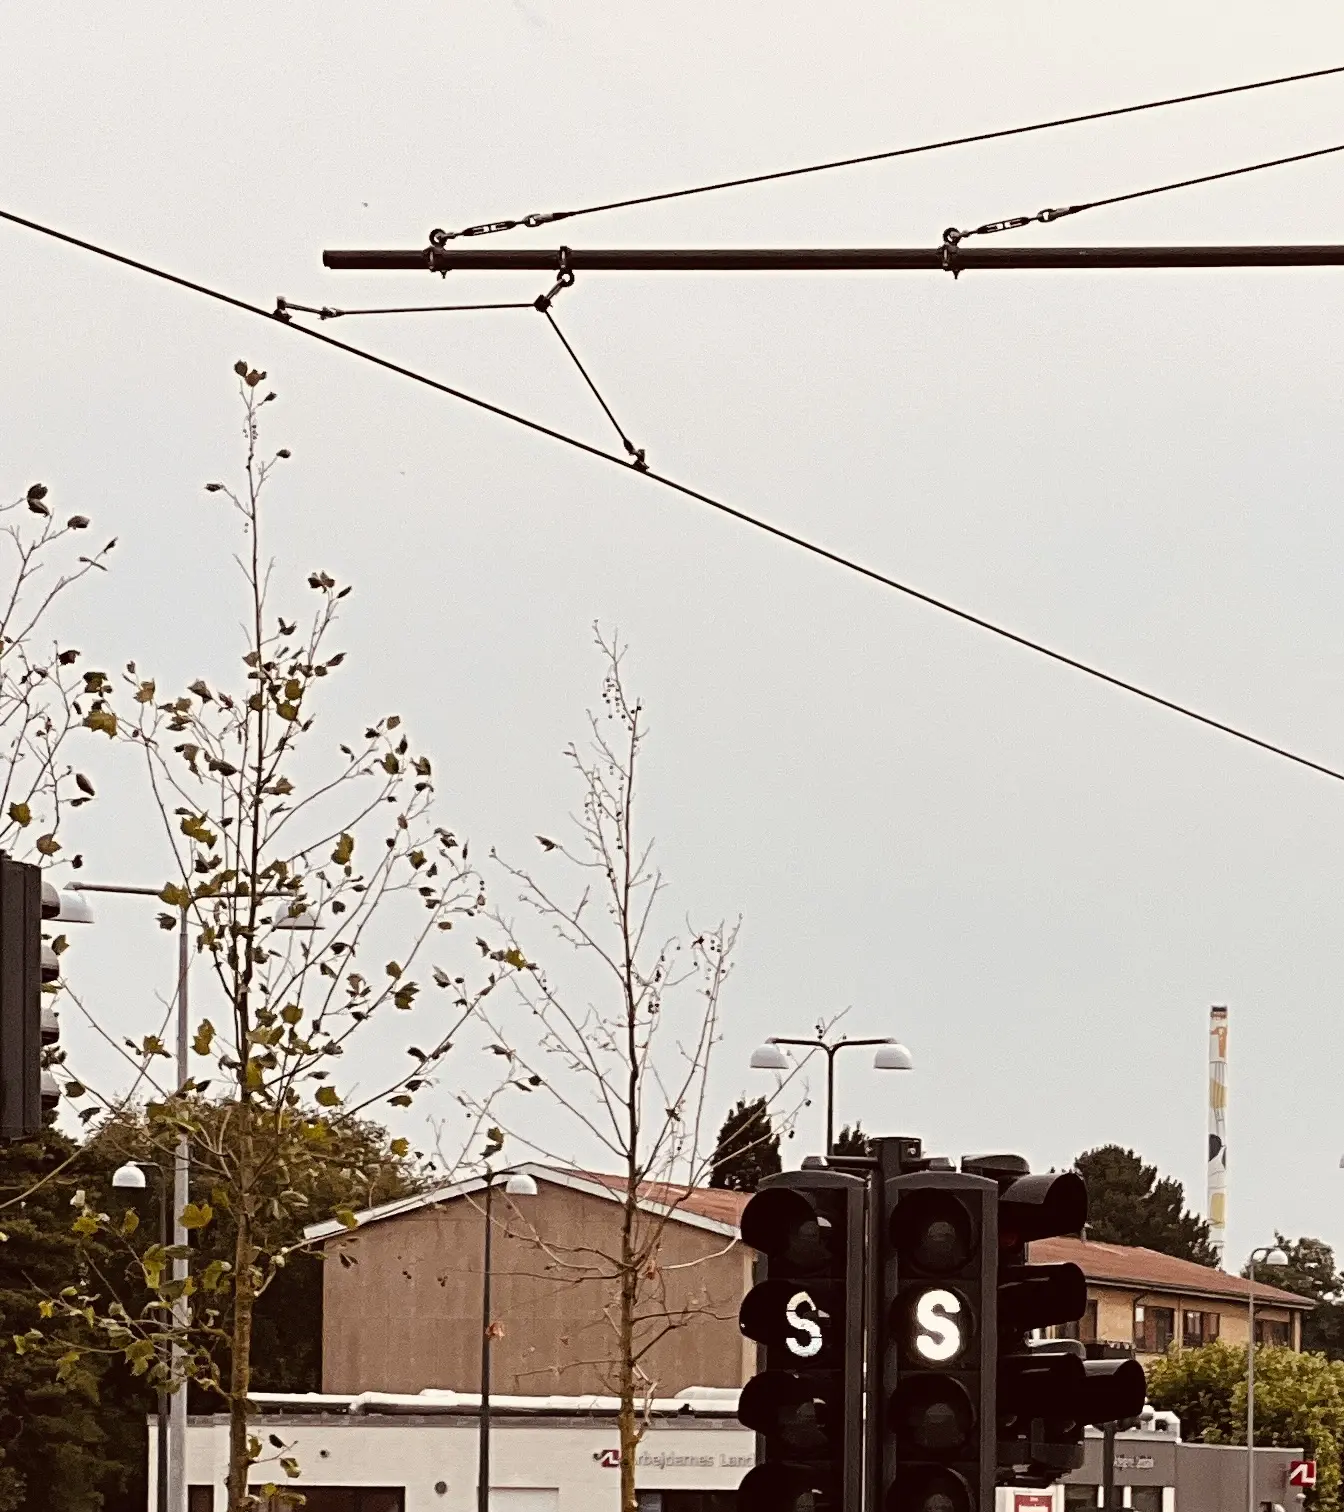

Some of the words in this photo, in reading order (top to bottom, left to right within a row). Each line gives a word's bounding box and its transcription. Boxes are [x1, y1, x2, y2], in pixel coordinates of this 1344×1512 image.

[785, 1291, 823, 1358] S
[916, 1289, 961, 1361] S
[636, 1451, 714, 1469] rbejdernes
